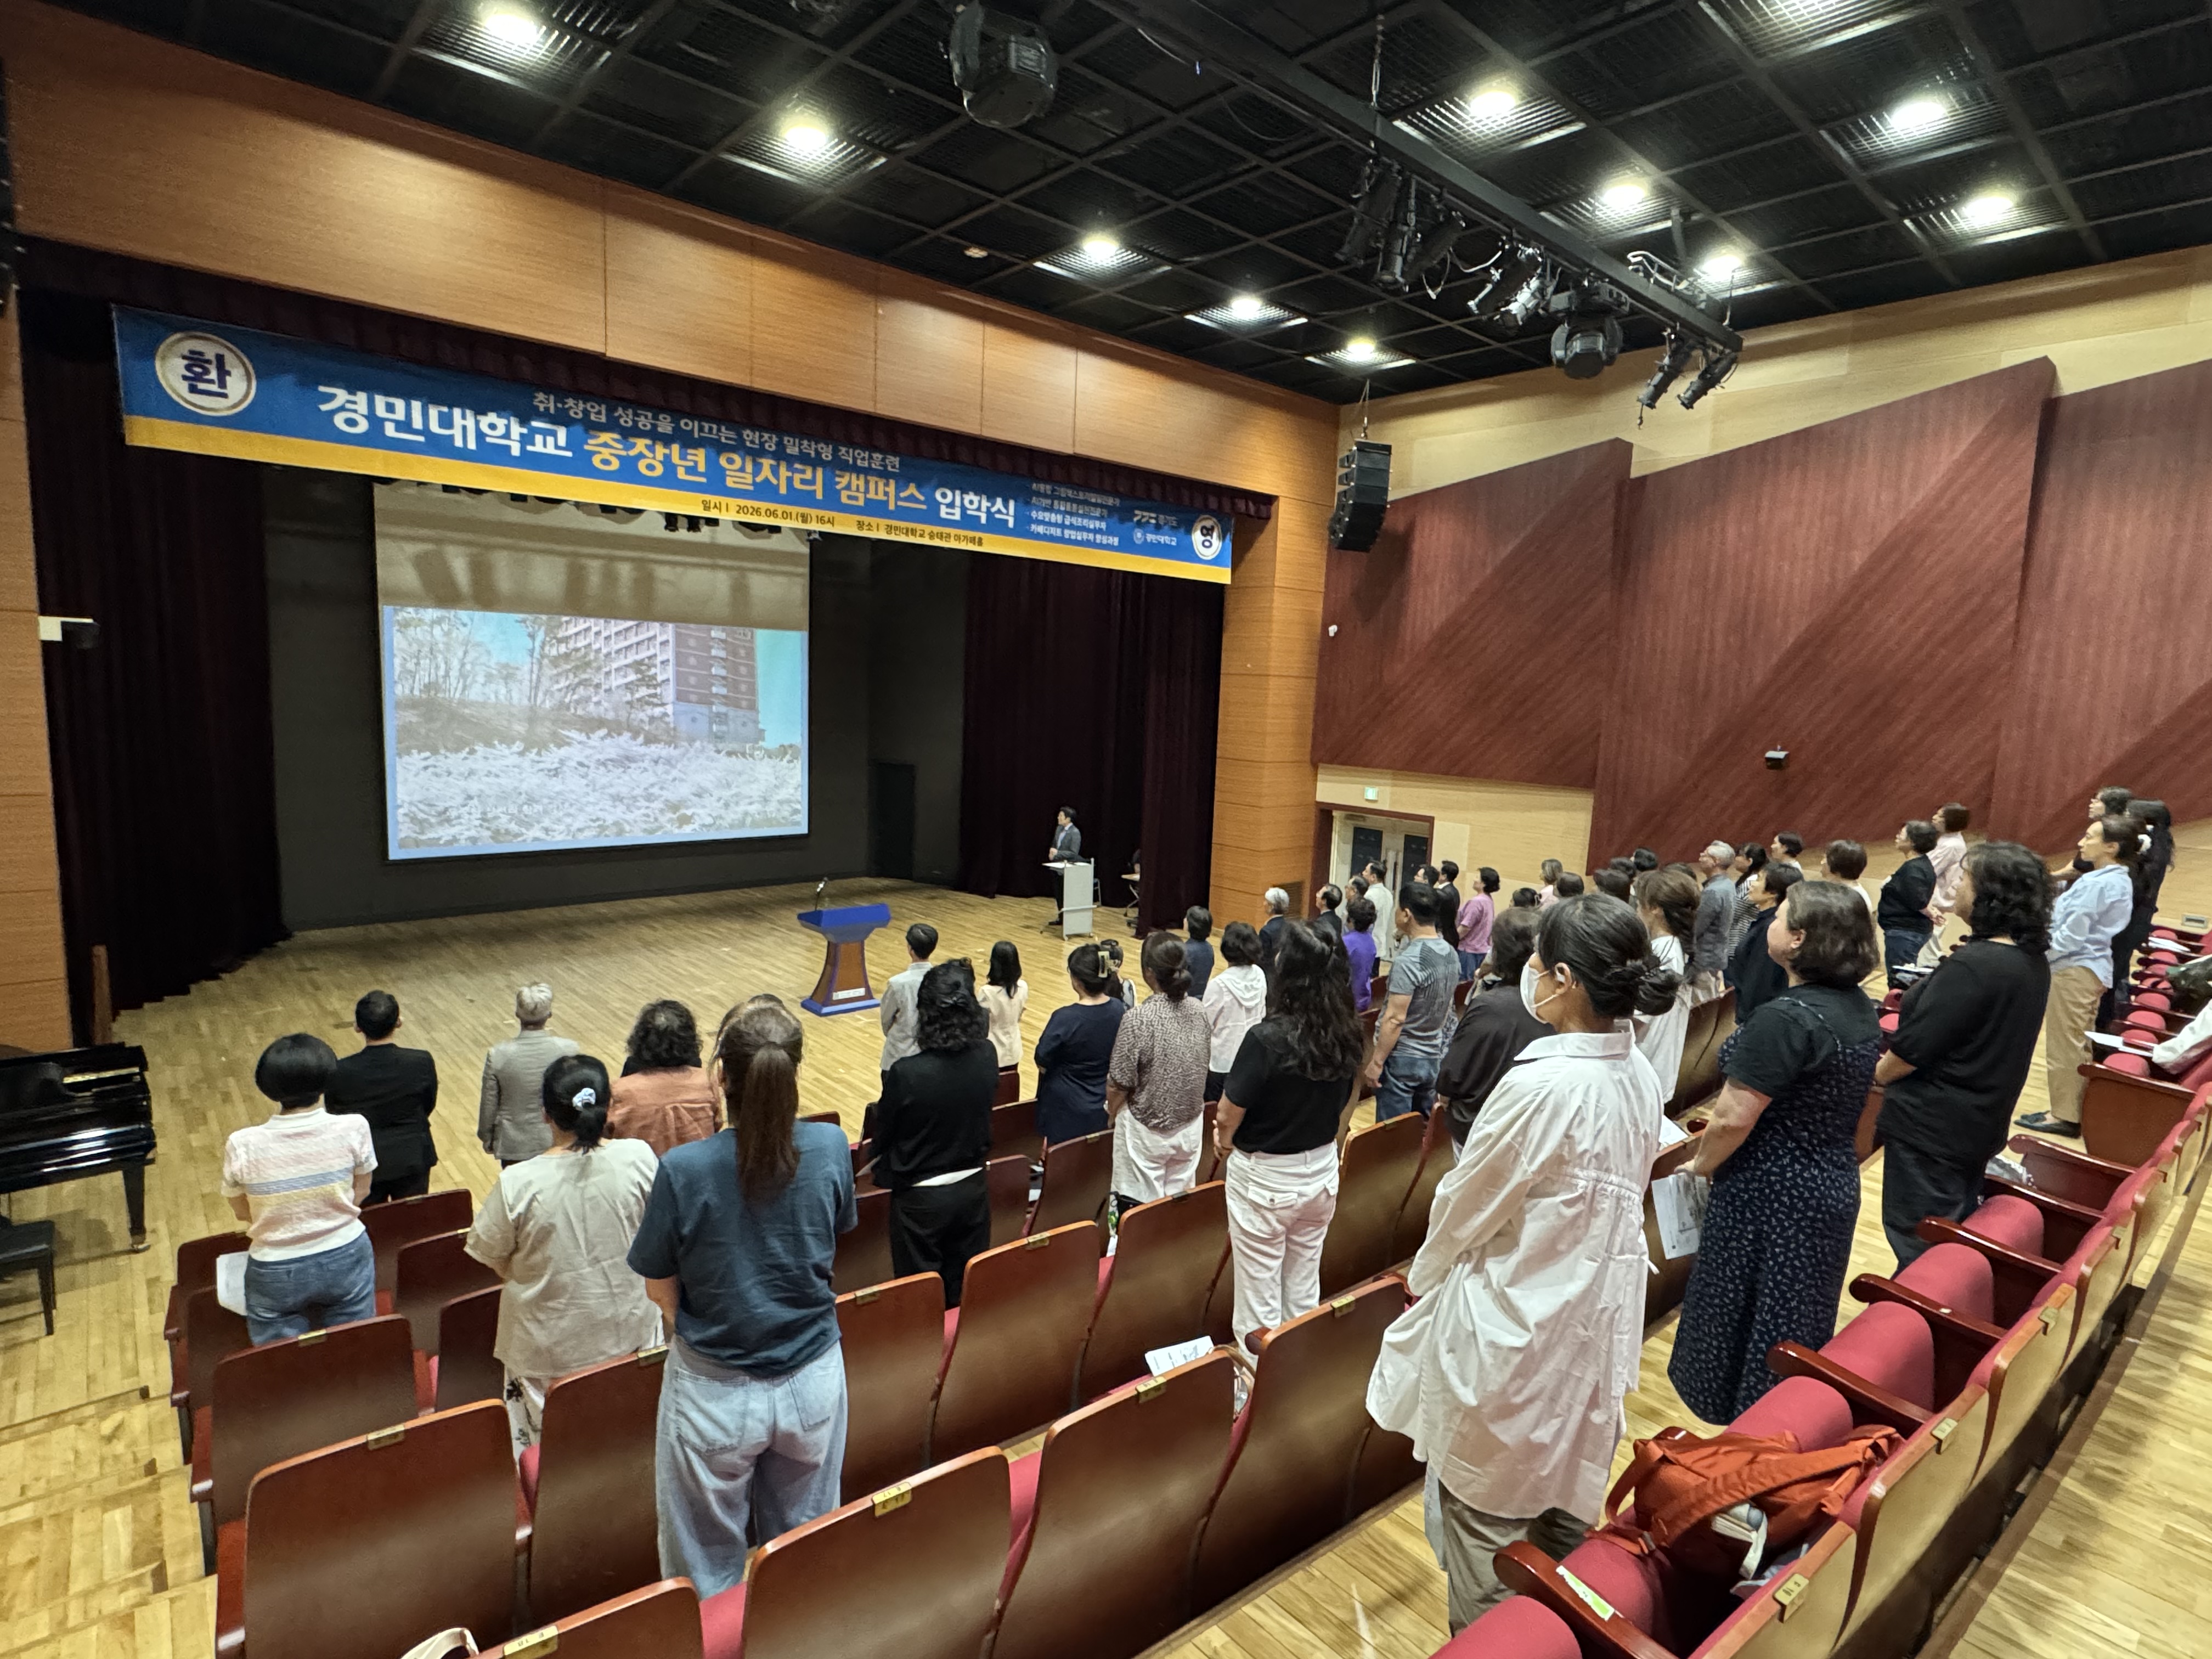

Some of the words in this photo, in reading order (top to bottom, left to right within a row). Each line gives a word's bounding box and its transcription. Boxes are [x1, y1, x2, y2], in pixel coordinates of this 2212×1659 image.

[180, 349, 232, 399] 환
[532, 391, 607, 424] 취·창업
[613, 406, 675, 435] 성공을
[679, 418, 737, 445] 이끄는
[742, 429, 778, 452] 현장
[783, 436, 833, 460] 밀착형
[838, 445, 900, 473] 직업훈련
[318, 385, 573, 456] 경민대학교
[583, 430, 707, 483] 중장년
[719, 452, 823, 500] 일자리
[834, 469, 927, 511] 캠퍼스
[934, 487, 1015, 529] 입학식
[701, 499, 722, 515] 일시
[735, 504, 813, 524] 2026.06.01.(월)
[815, 515, 835, 527] 16시
[856, 520, 874, 532] 장소
[884, 524, 926, 539] 경민대학교
[1200, 524, 1215, 549] 영
